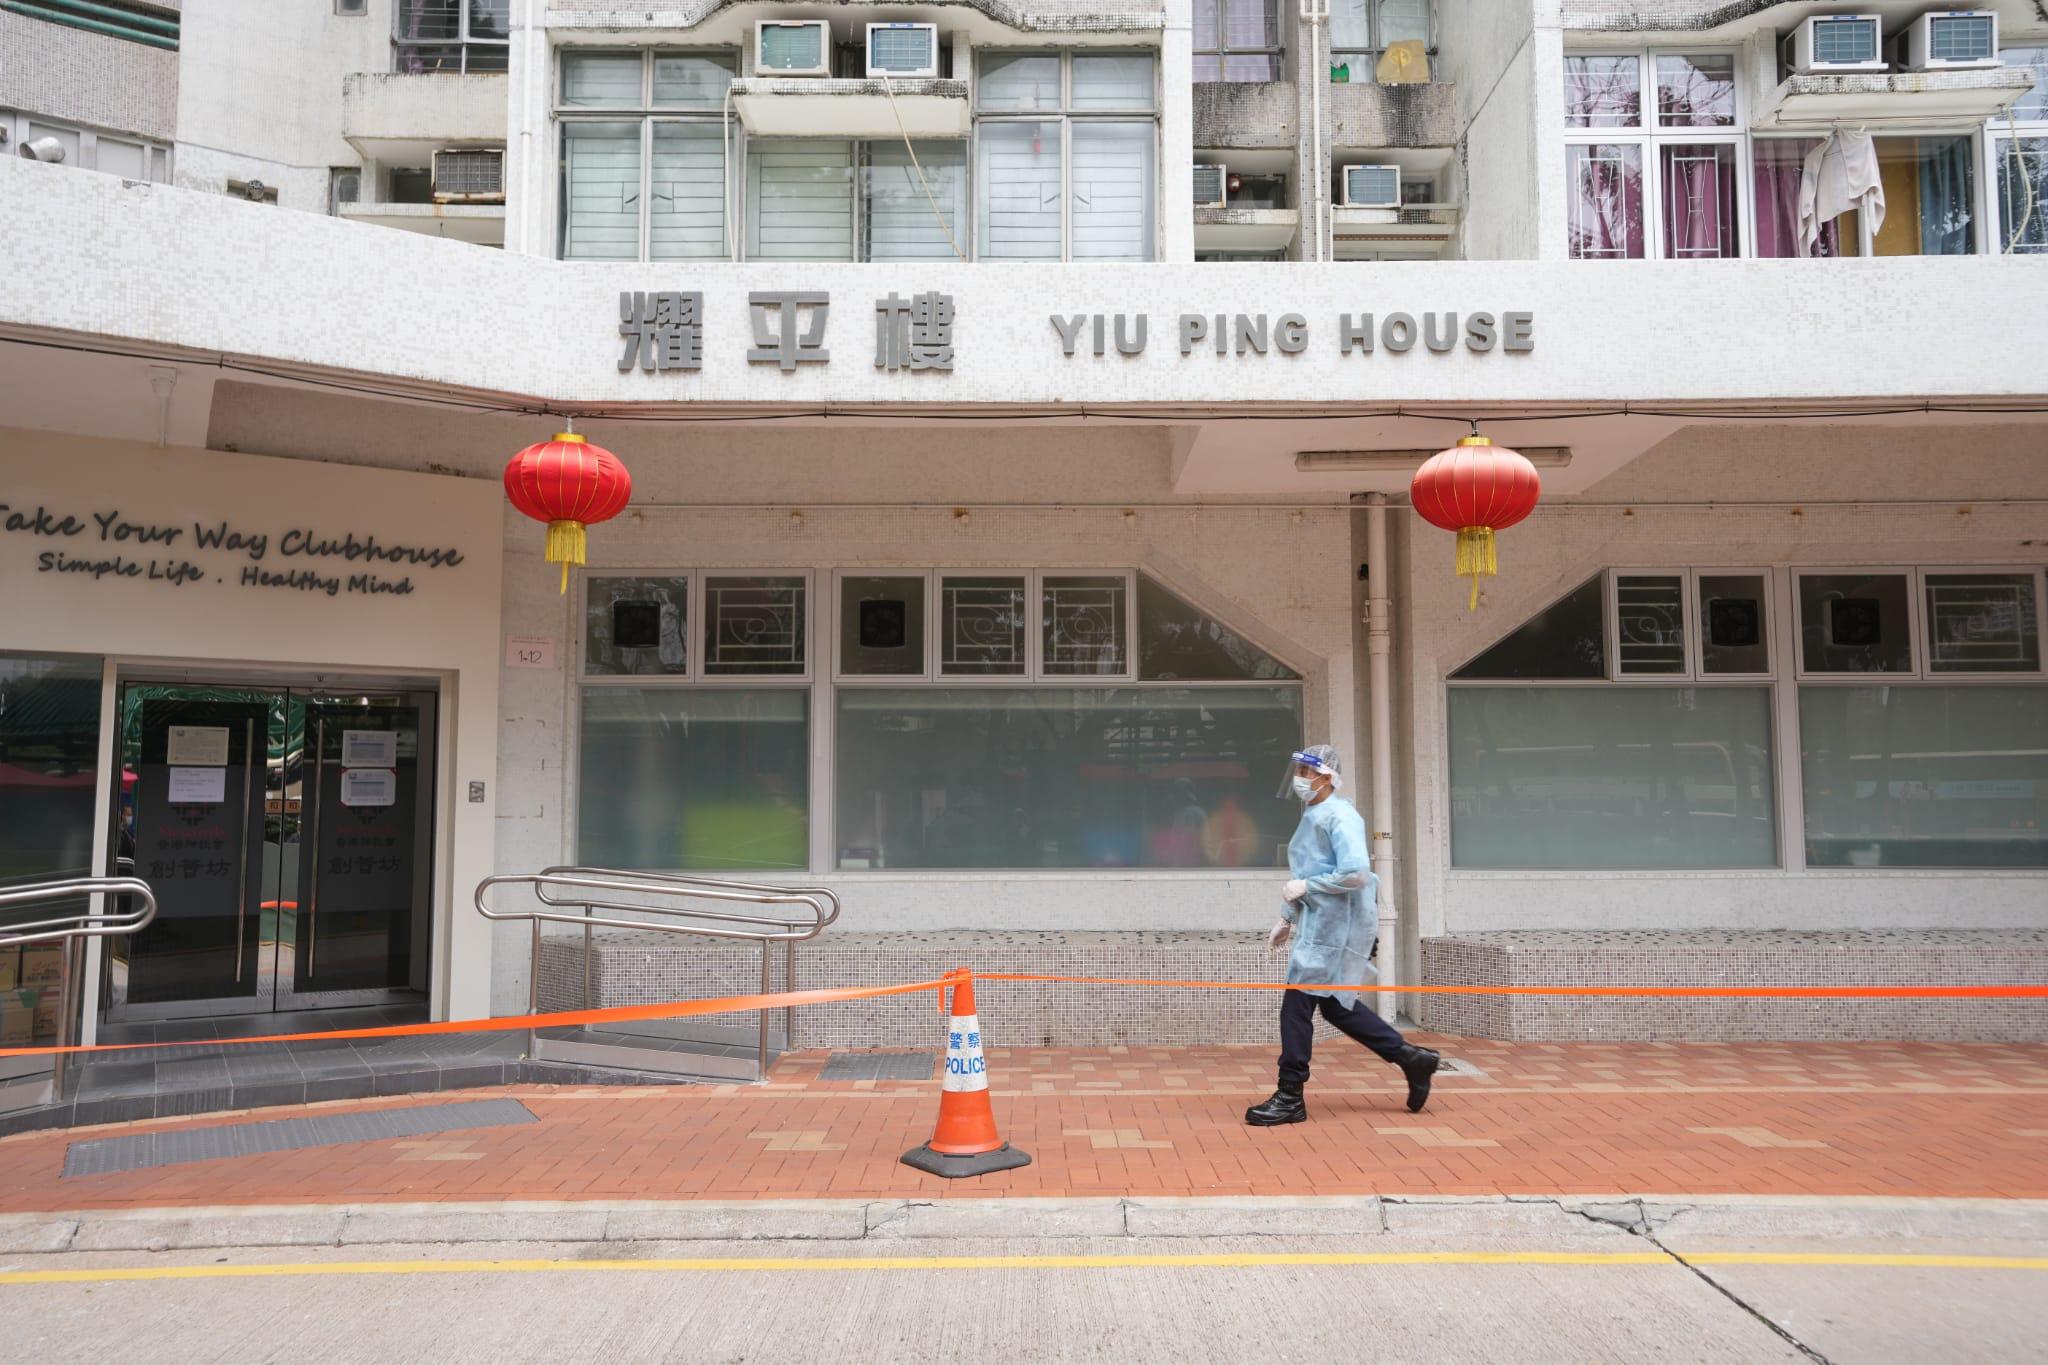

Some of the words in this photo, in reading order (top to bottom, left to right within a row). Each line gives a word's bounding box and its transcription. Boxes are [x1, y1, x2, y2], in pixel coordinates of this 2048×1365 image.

[618, 291, 953, 372] 耀平樓
[1050, 313, 1148, 355] YIU
[1179, 312, 1309, 354] PING
[1340, 311, 1535, 353] HOUSE
[93, 510, 183, 546] Your
[195, 521, 267, 560] Way
[280, 529, 464, 568] Clubhouse
[38, 551, 142, 580] Simple
[148, 560, 204, 586] Life
[241, 566, 340, 596] Healthy
[347, 574, 414, 595] Mind
[518, 650, 543, 664] 1-12
[950, 1032, 980, 1049] 警察
[945, 1056, 985, 1074] POLICE
